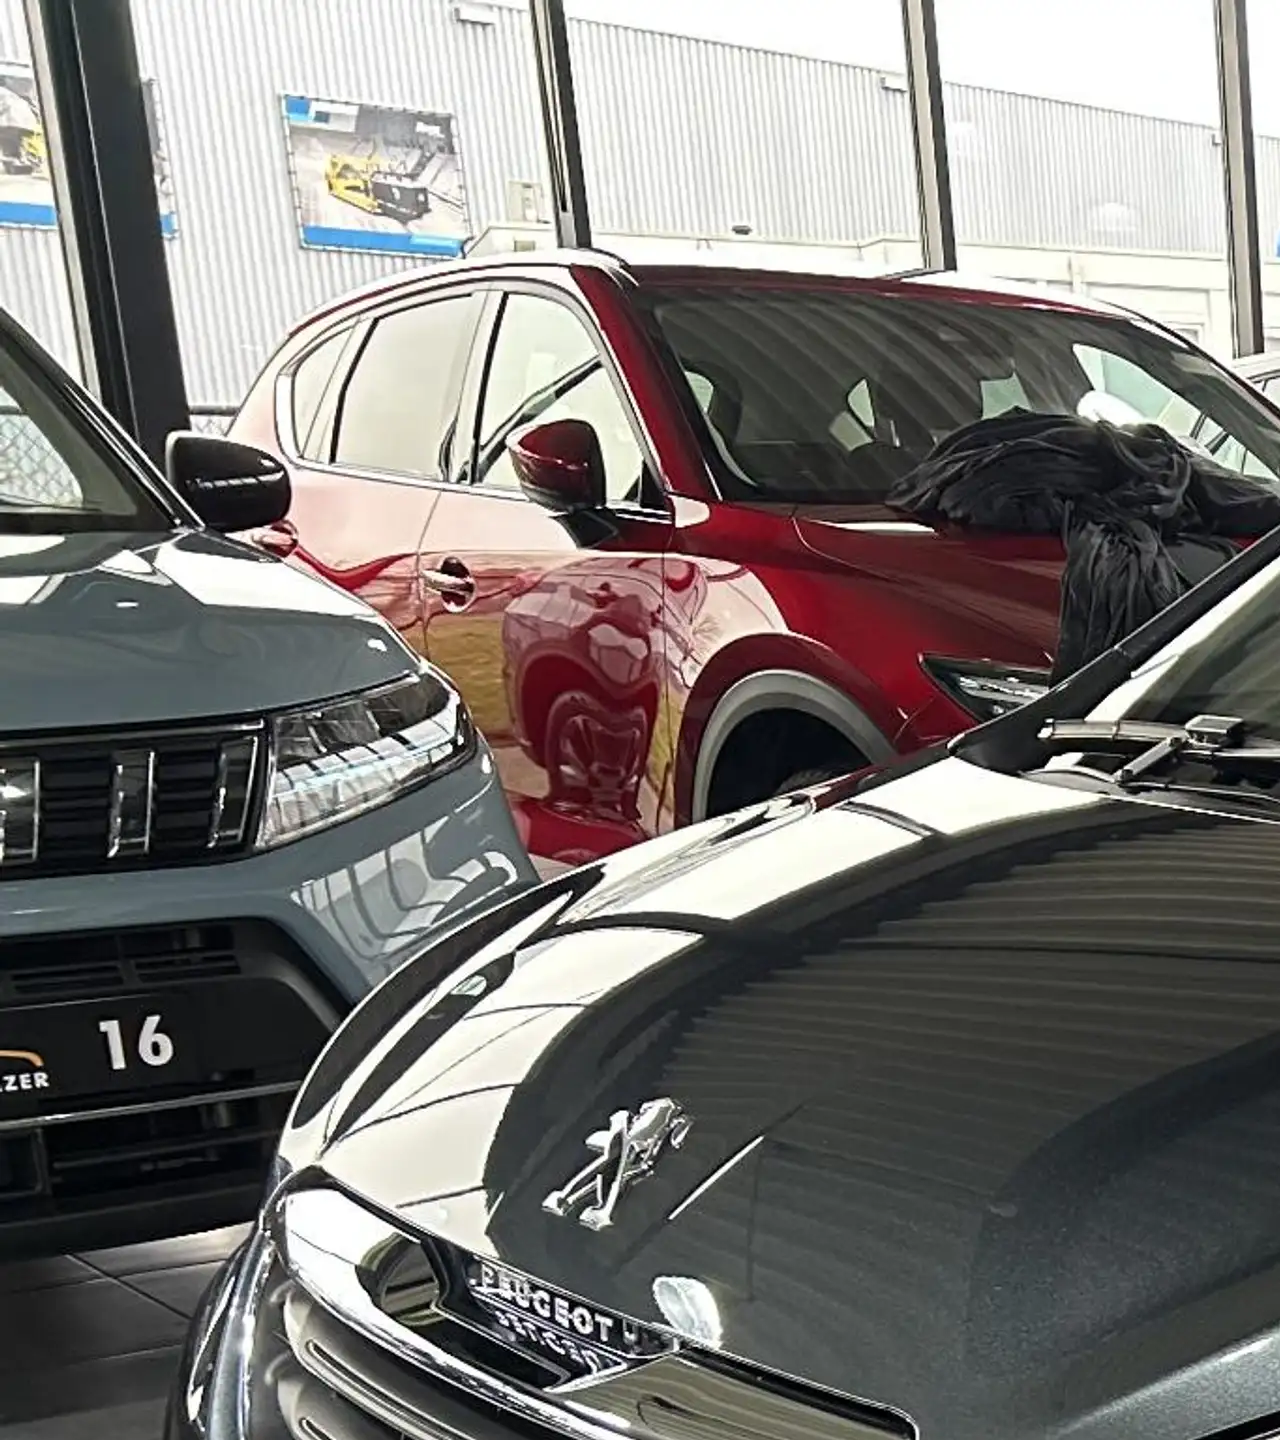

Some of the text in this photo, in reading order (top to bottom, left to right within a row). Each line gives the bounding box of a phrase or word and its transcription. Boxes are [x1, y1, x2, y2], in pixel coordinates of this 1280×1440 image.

[99, 1014, 174, 1071] 16
[0, 1071, 50, 1094] ZER
[480, 1262, 615, 1343] PEUGEOT
